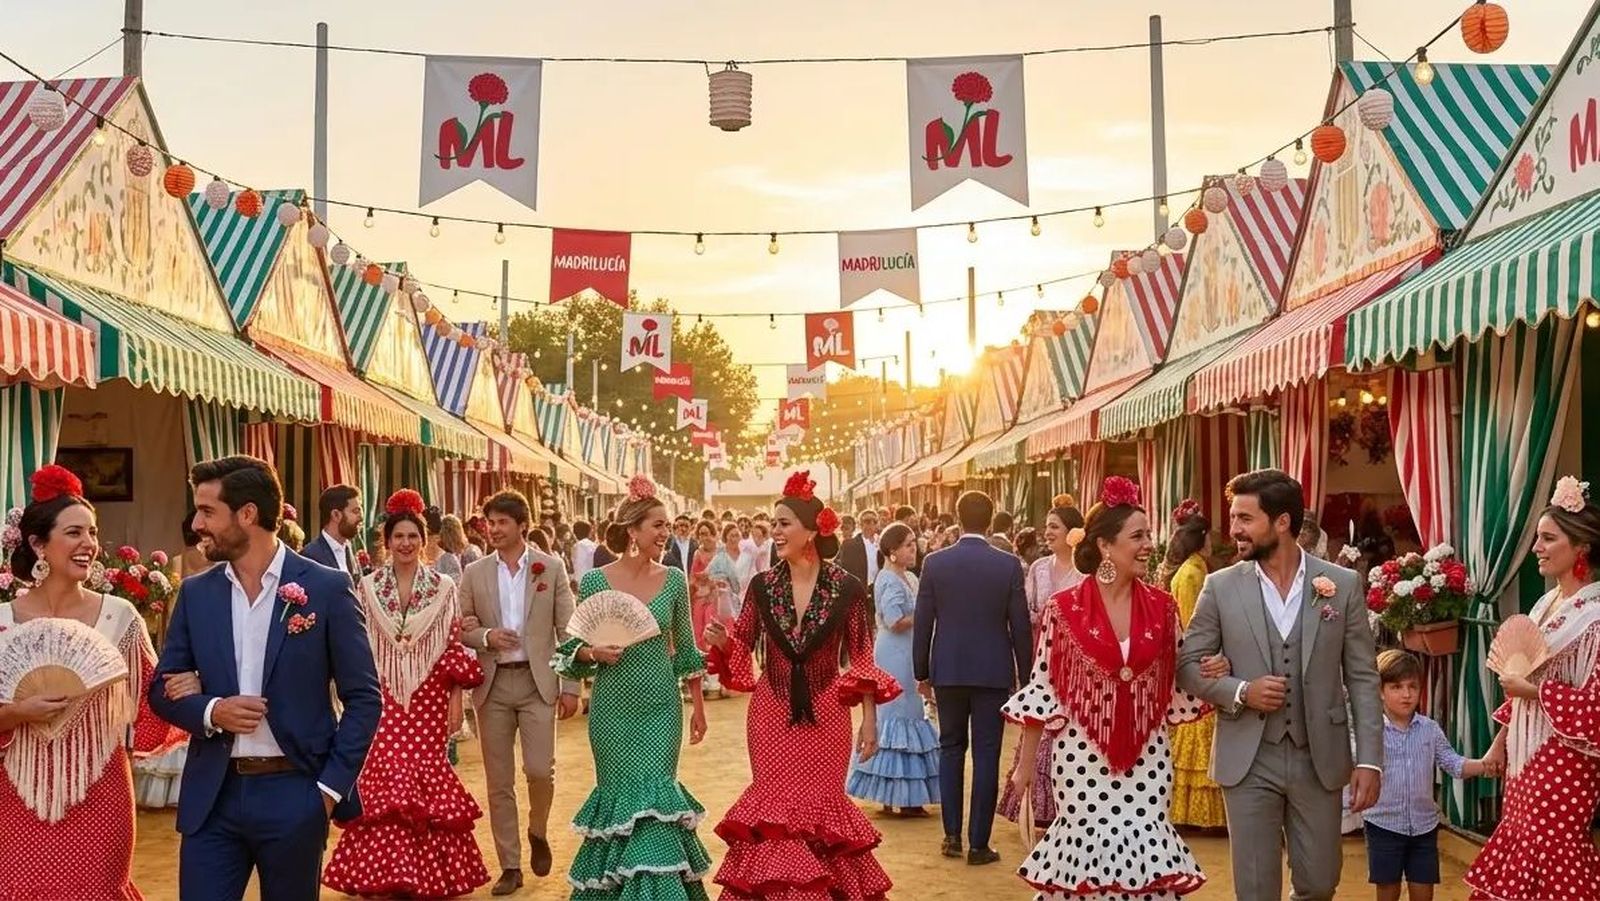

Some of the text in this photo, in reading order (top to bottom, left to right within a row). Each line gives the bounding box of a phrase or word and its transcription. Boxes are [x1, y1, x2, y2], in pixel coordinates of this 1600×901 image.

[437, 110, 525, 170] ML
[924, 109, 1014, 171] ML
[1570, 97, 1600, 173] M
[554, 255, 627, 272] MADRILUCÍA
[842, 252, 916, 272] MADRILUCÍA
[629, 334, 665, 358] ML
[813, 332, 850, 358] ML
